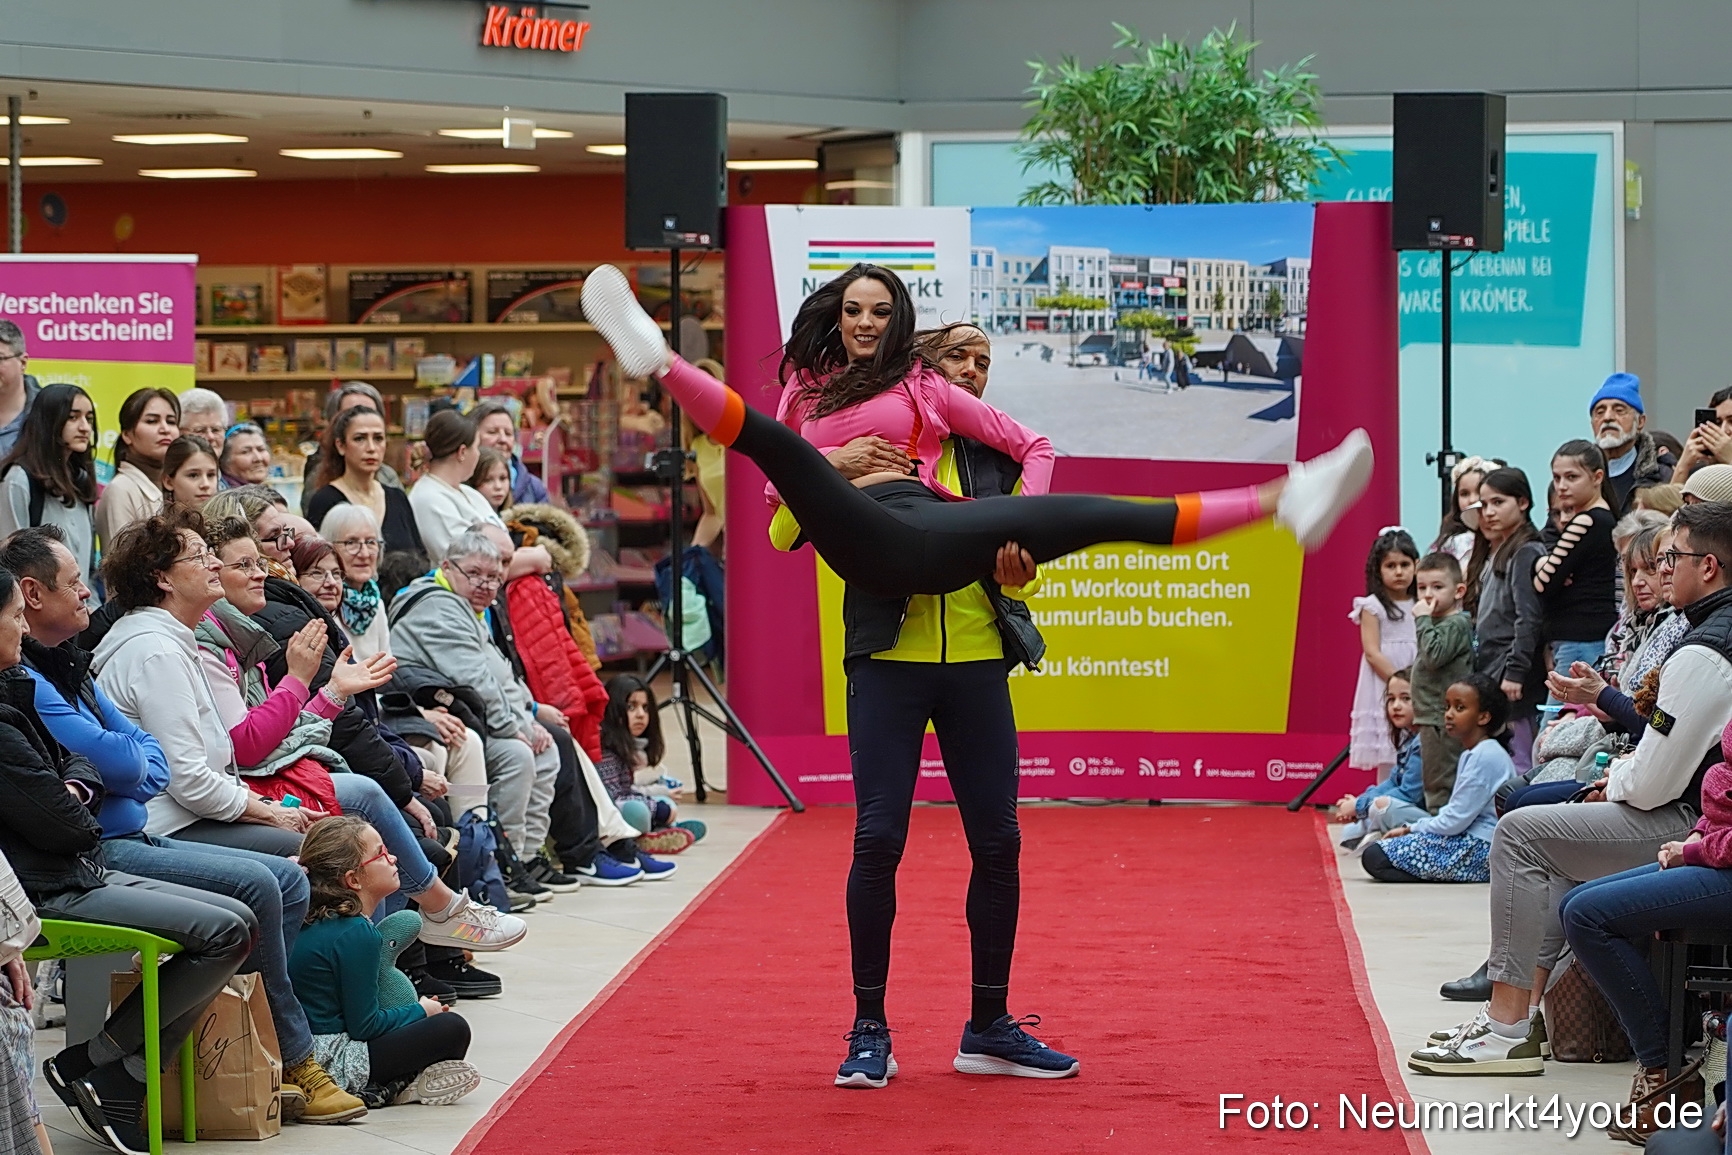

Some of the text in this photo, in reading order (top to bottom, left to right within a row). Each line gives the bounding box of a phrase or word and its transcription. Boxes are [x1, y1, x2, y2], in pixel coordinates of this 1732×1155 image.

[482, 5, 591, 52] Krömer
[1504, 218, 1551, 244] PIELE
[1417, 256, 1441, 278] GIB
[1469, 256, 1526, 277] NEBENAN
[1531, 256, 1552, 277] BEI
[138, 291, 174, 315] Sie
[1399, 283, 1534, 314] WARE KRÖMER.
[36, 317, 174, 342] Gutscheine!
[1093, 554, 1120, 570] an
[1123, 549, 1192, 571] einem
[1195, 550, 1230, 571] Ort
[1070, 578, 1163, 599] Workout
[1166, 578, 1251, 599] machen
[1030, 606, 1234, 627] aumurlaub buchen.
[1066, 657, 1170, 677] könntest!
